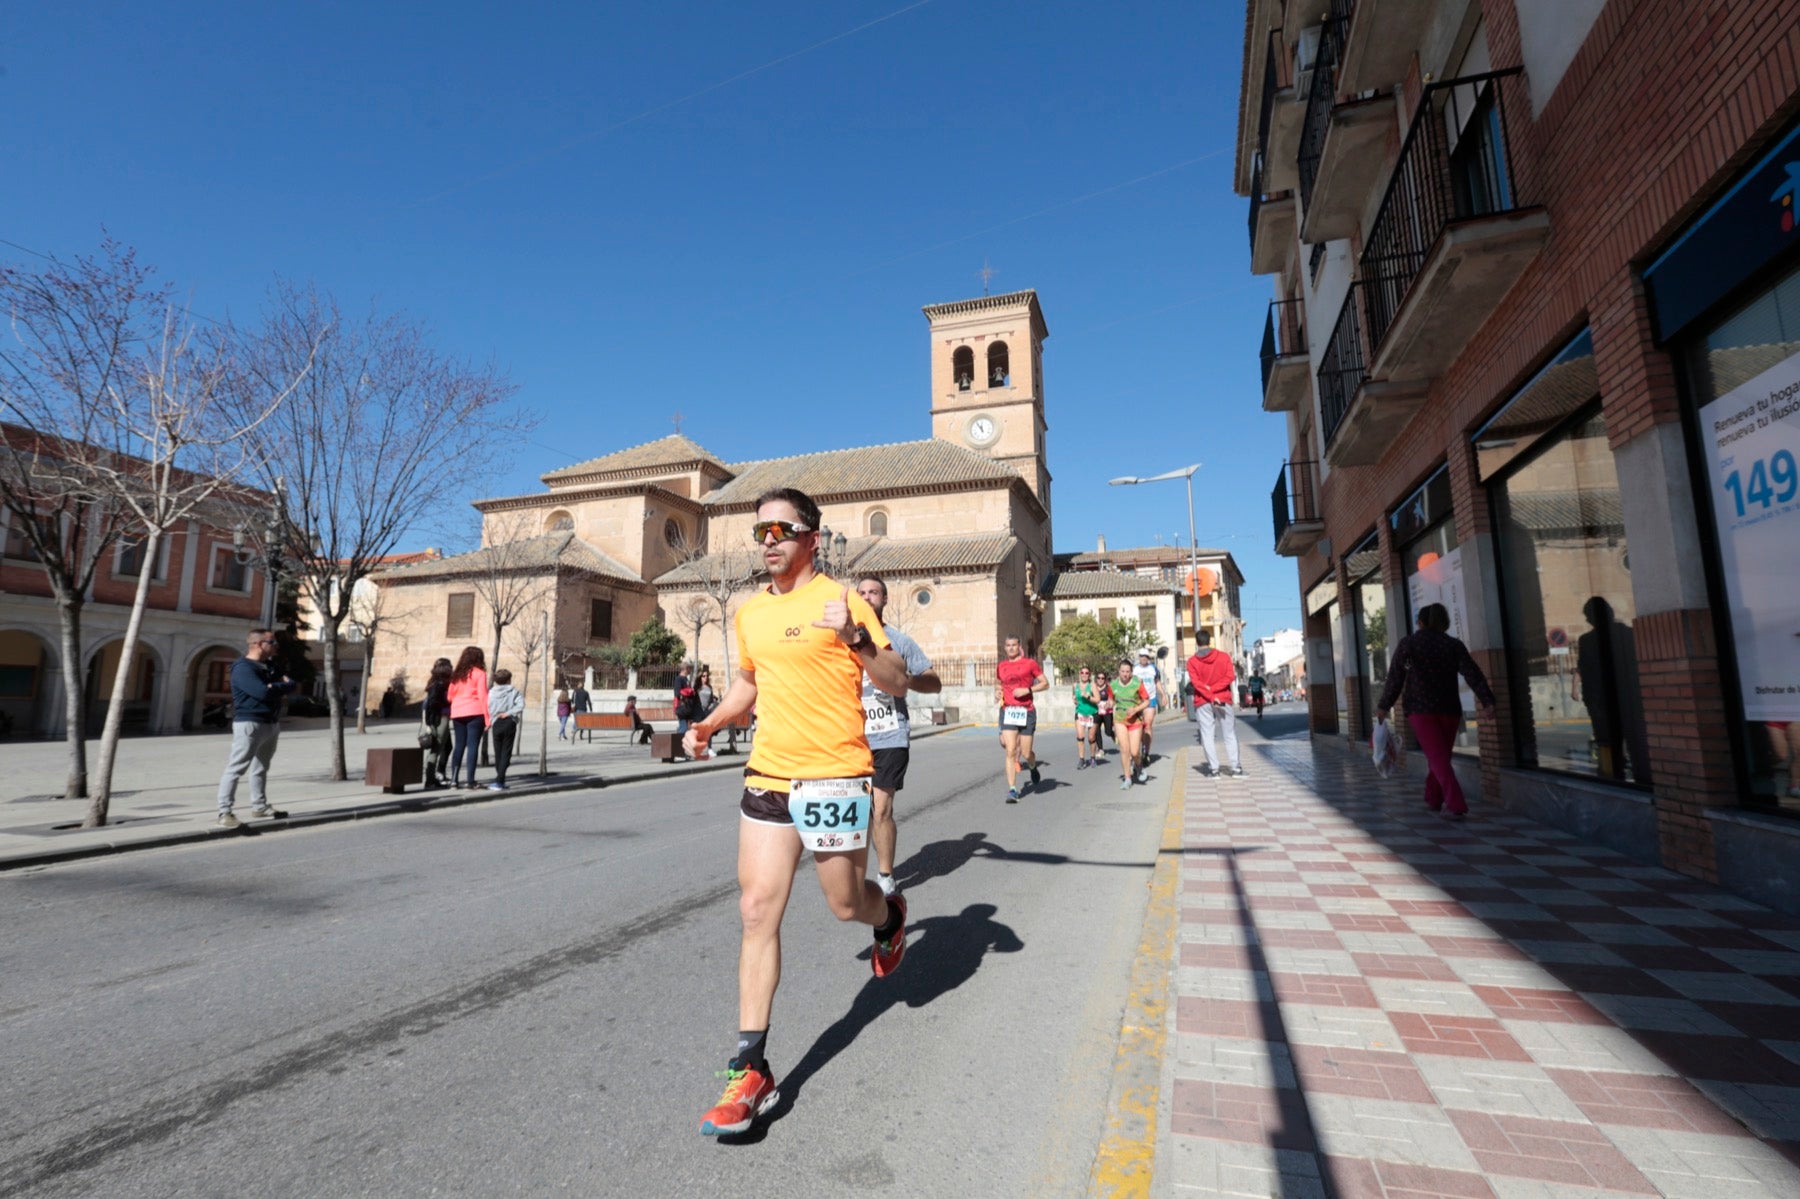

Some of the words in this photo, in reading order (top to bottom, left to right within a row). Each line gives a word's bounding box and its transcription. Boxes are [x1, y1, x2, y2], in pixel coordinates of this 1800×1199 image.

[1714, 405, 1755, 434] Renueva
[1756, 398, 1769, 411] tu
[1716, 423, 1755, 449] renueva
[1756, 416, 1769, 429] tu
[1723, 448, 1798, 518] 149
[785, 626, 801, 637] GO
[803, 801, 859, 828] 534
